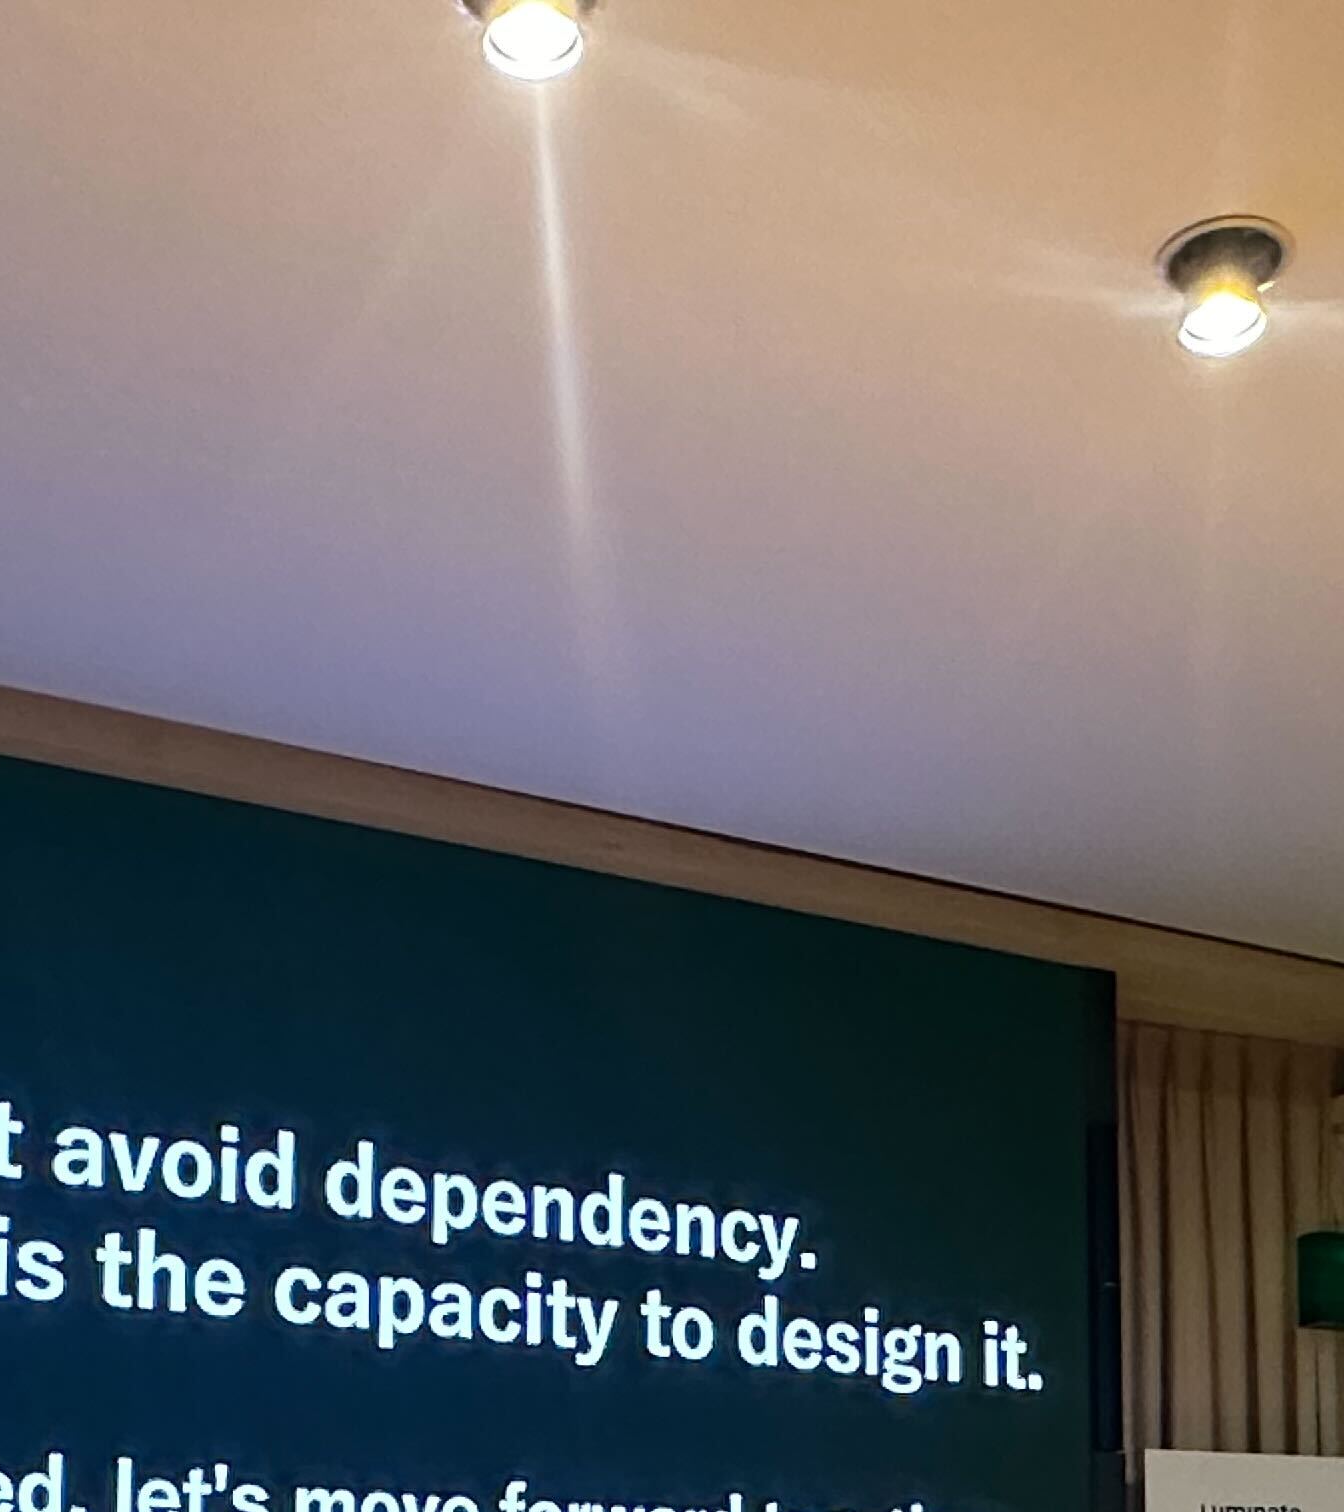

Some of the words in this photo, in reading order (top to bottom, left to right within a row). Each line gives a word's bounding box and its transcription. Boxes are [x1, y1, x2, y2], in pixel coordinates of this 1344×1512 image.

[51, 1124, 295, 1210] avoid
[324, 1140, 816, 1281] dependency.
[95, 1228, 246, 1318] the
[274, 1266, 620, 1366] capacity
[640, 1288, 714, 1360] to
[737, 1294, 961, 1394] design
[982, 1320, 1044, 1391] it.
